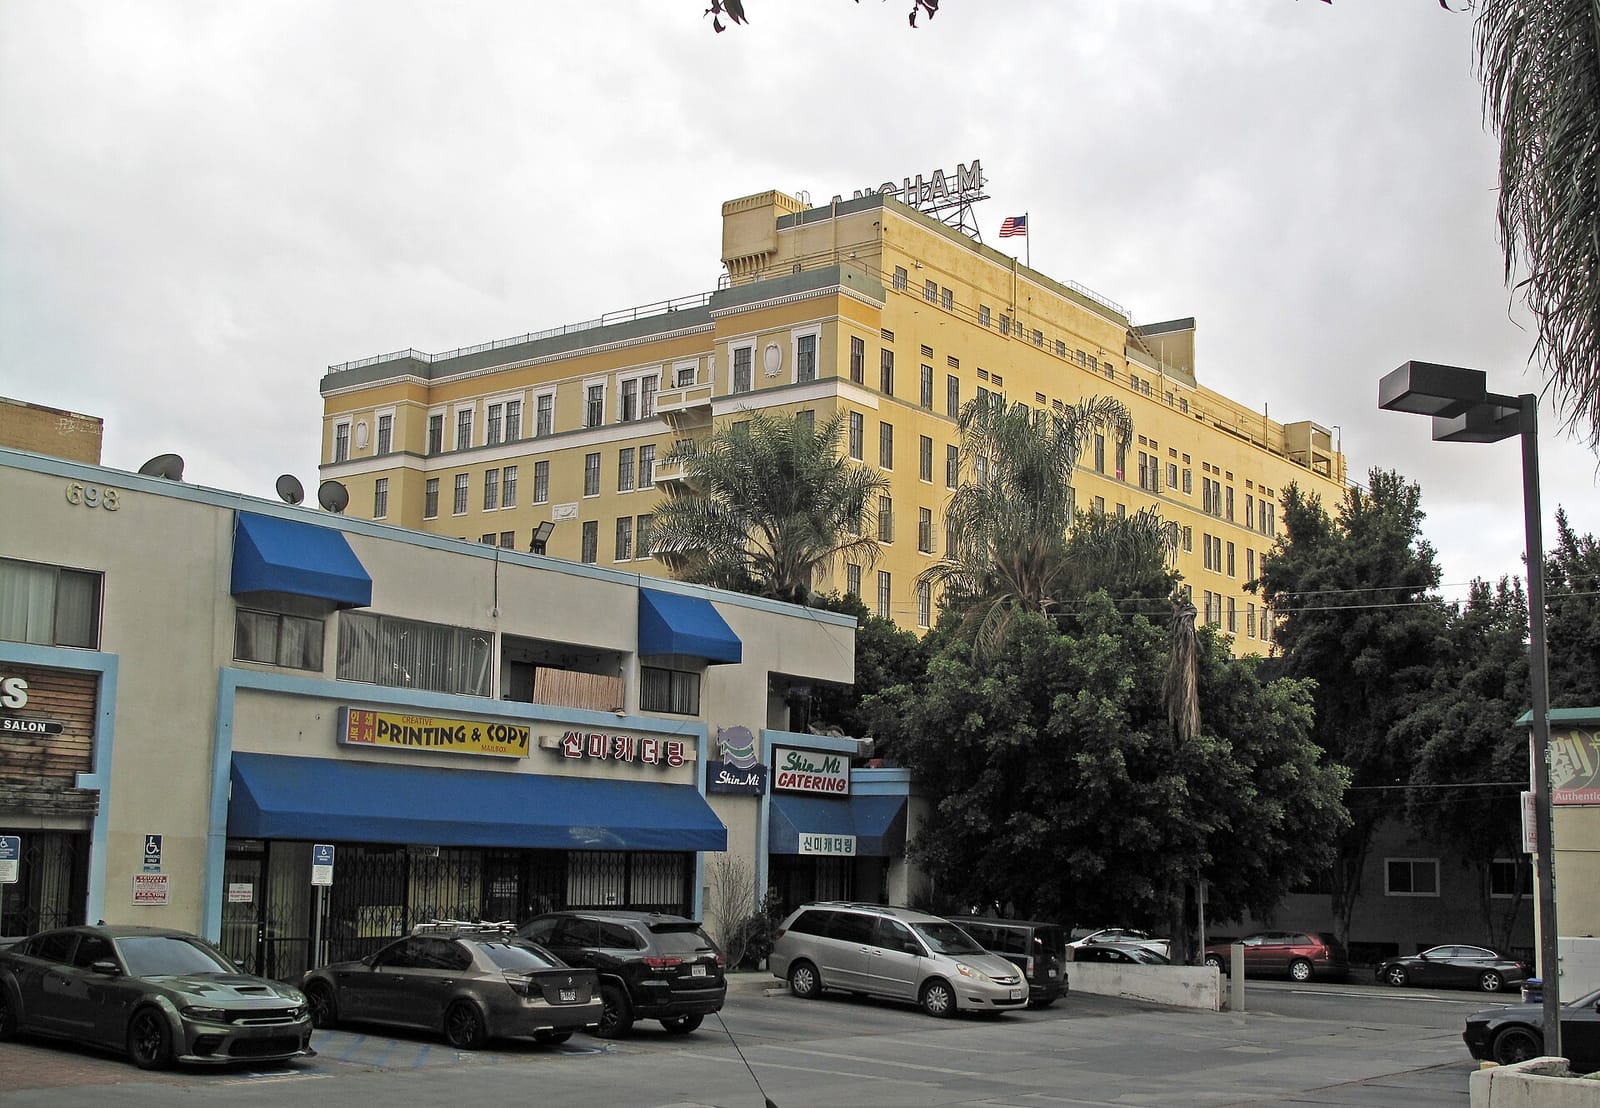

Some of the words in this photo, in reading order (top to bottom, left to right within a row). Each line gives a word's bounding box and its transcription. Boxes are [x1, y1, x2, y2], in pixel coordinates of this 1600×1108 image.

[832, 159, 982, 204] HAM
[66, 482, 120, 511] 698
[0, 677, 28, 709] S
[4, 720, 46, 732] SALON
[402, 716, 433, 726] CREATIVE
[377, 718, 466, 746] PRINTING
[471, 728, 481, 742] &
[486, 724, 528, 748] COPY
[481, 744, 507, 753] MAILBOX
[564, 731, 684, 767] 신미캐더링
[781, 752, 814, 773] Shin
[777, 772, 846, 792] CATERING
[1555, 791, 1600, 801] Authentic
